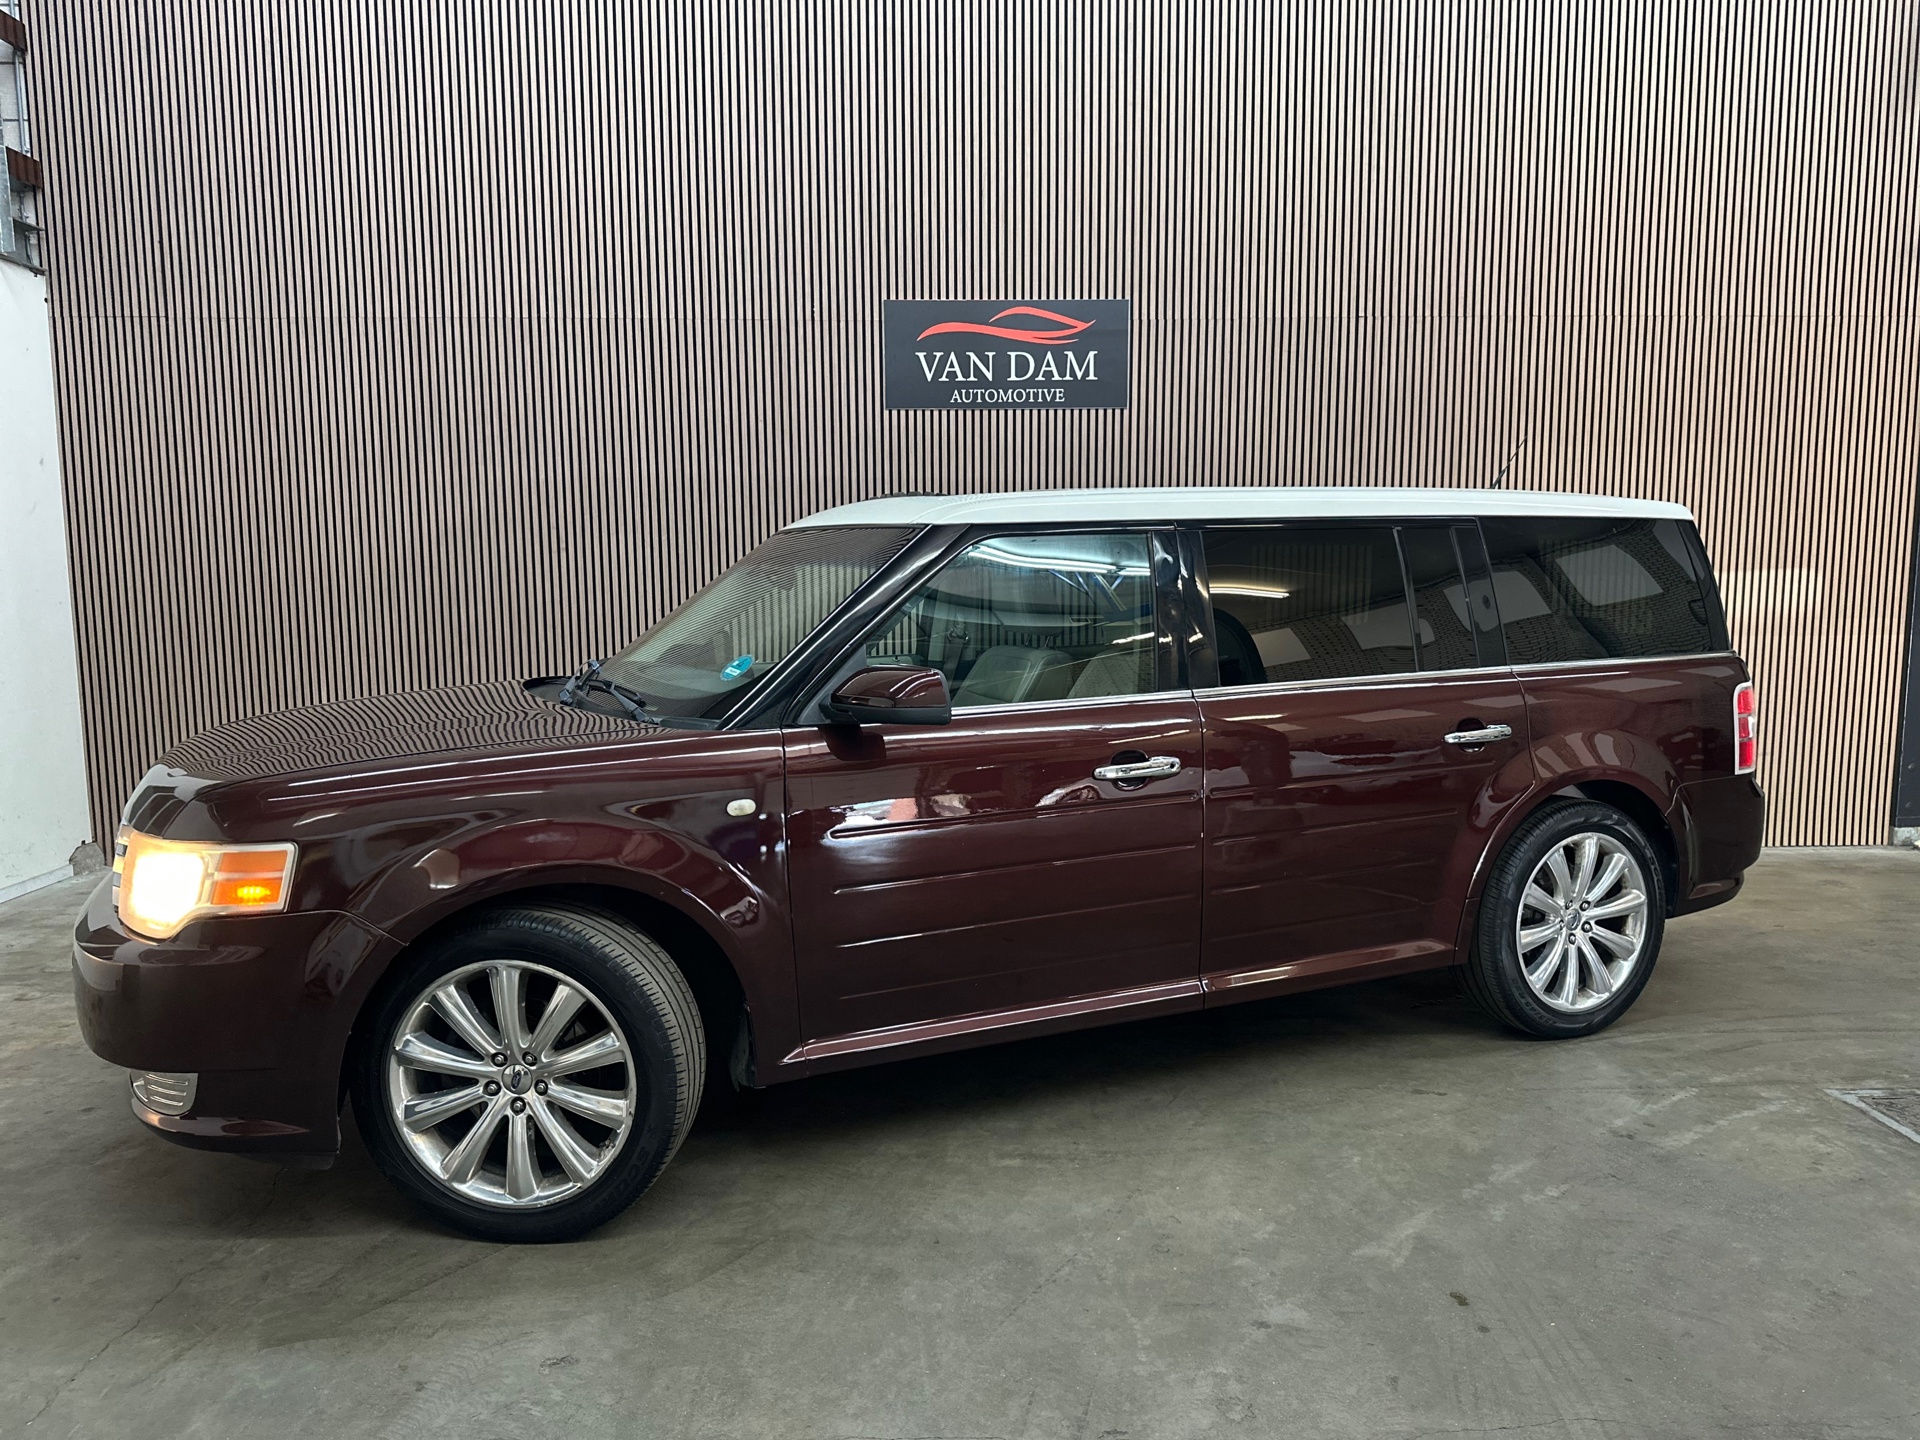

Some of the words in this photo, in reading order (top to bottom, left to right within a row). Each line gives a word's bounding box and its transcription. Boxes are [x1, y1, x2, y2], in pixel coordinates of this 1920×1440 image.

[915, 351, 996, 382] VAN
[1006, 350, 1098, 381] DAM
[950, 388, 1065, 403] AUTOMOTIVE
